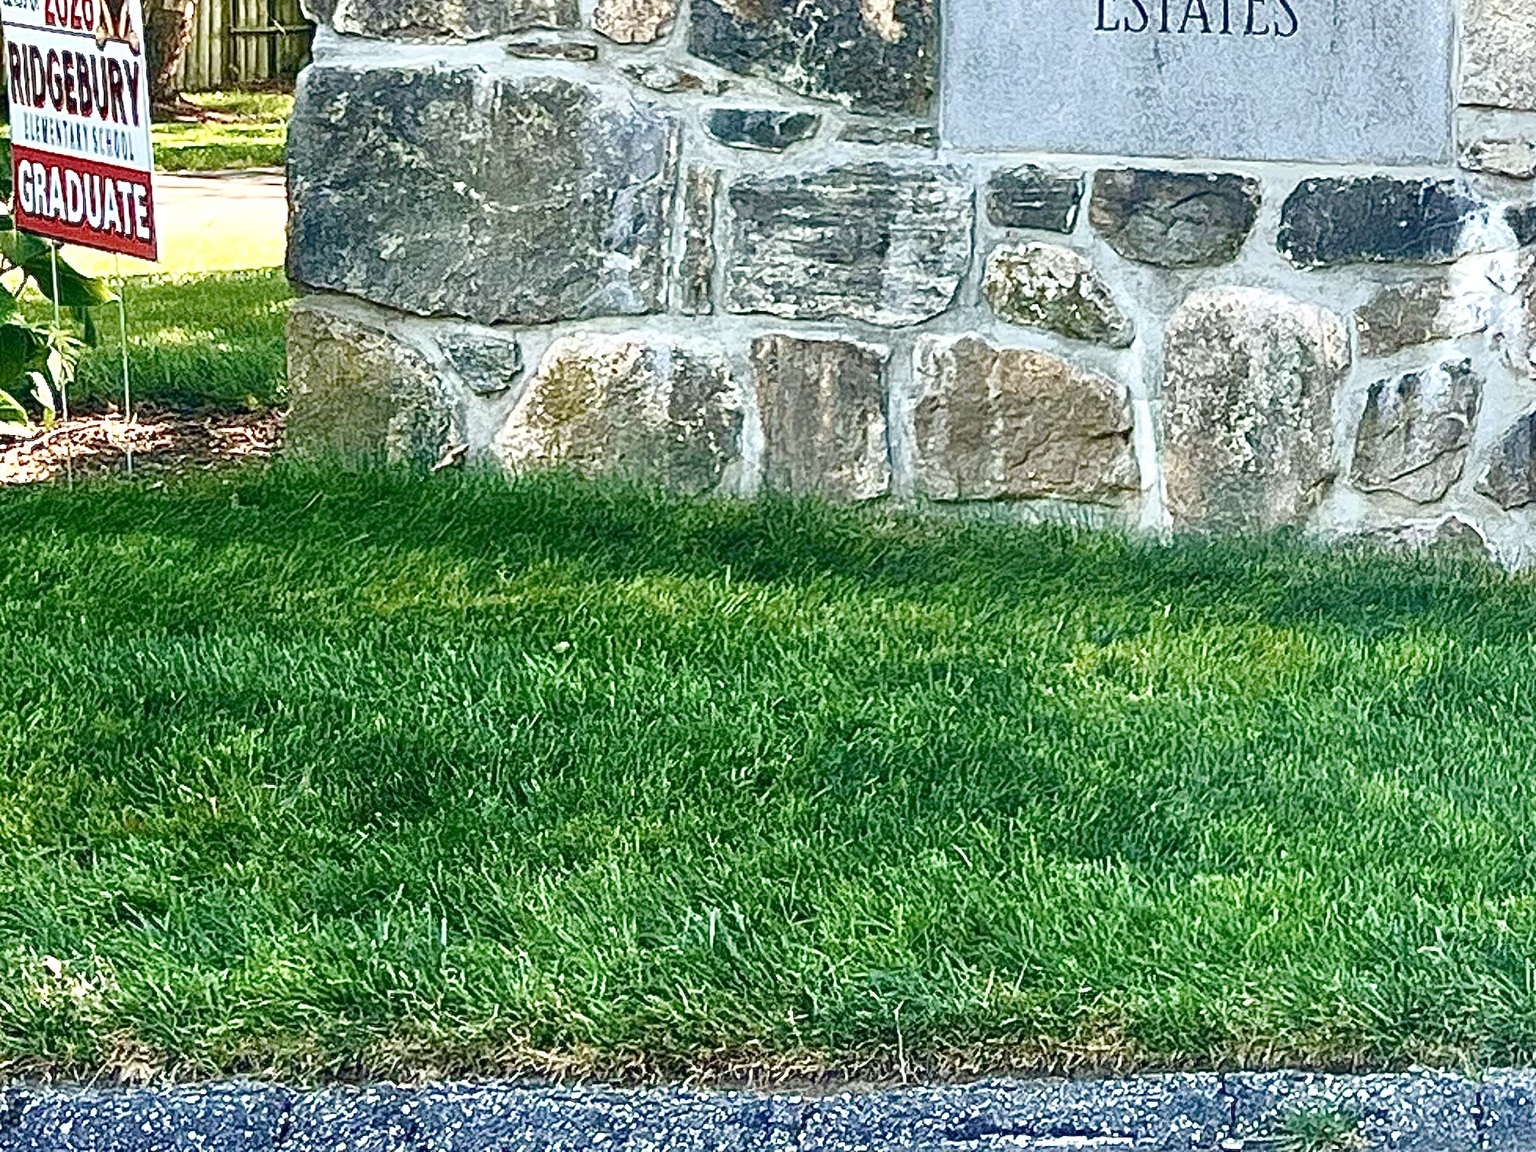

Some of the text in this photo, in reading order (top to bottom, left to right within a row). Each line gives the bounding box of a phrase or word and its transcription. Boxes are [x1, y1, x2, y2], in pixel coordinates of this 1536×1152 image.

[7, 40, 140, 127] RIDGEBURY
[92, 125, 135, 161] SCHOOL
[18, 158, 152, 241] GRADUATE
